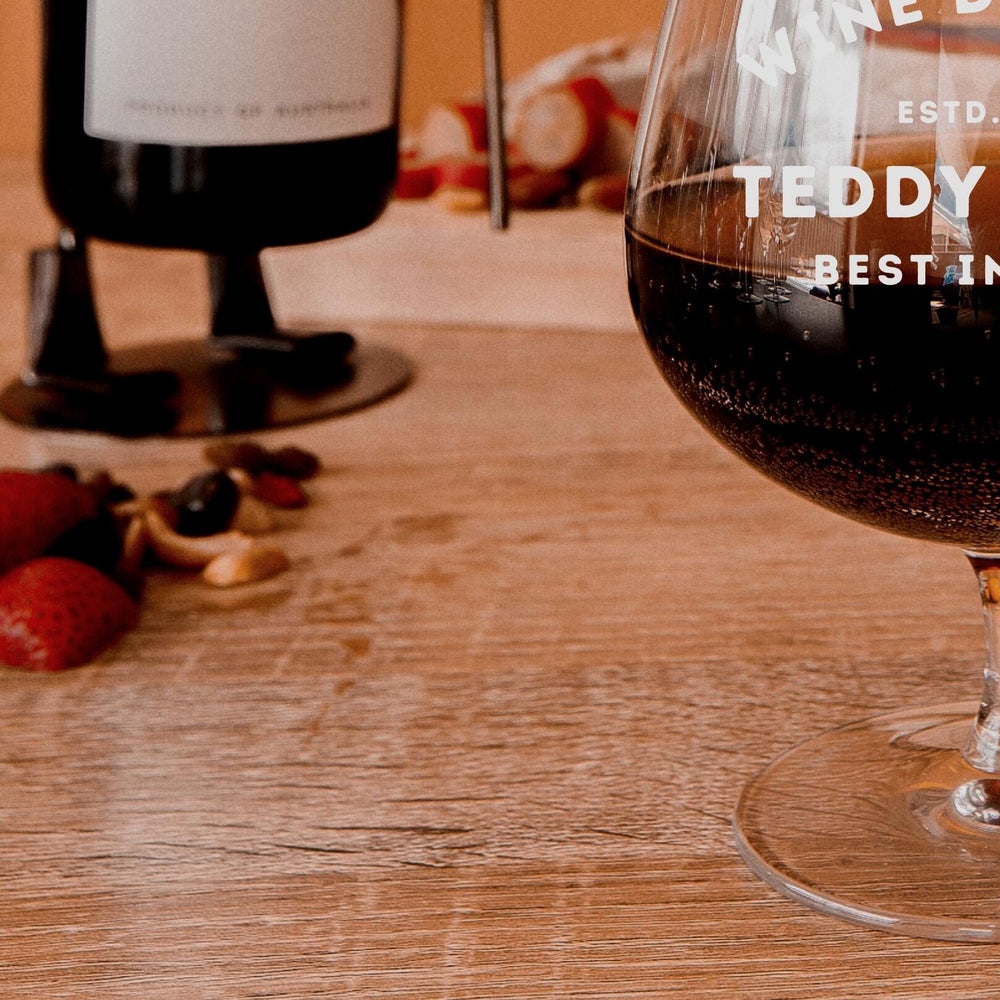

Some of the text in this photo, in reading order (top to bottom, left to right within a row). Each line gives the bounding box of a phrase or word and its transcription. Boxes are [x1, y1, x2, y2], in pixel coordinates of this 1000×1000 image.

[899, 101, 999, 124] ESTD.
[733, 166, 986, 218] TEDDY
[814, 254, 934, 286] BEST
